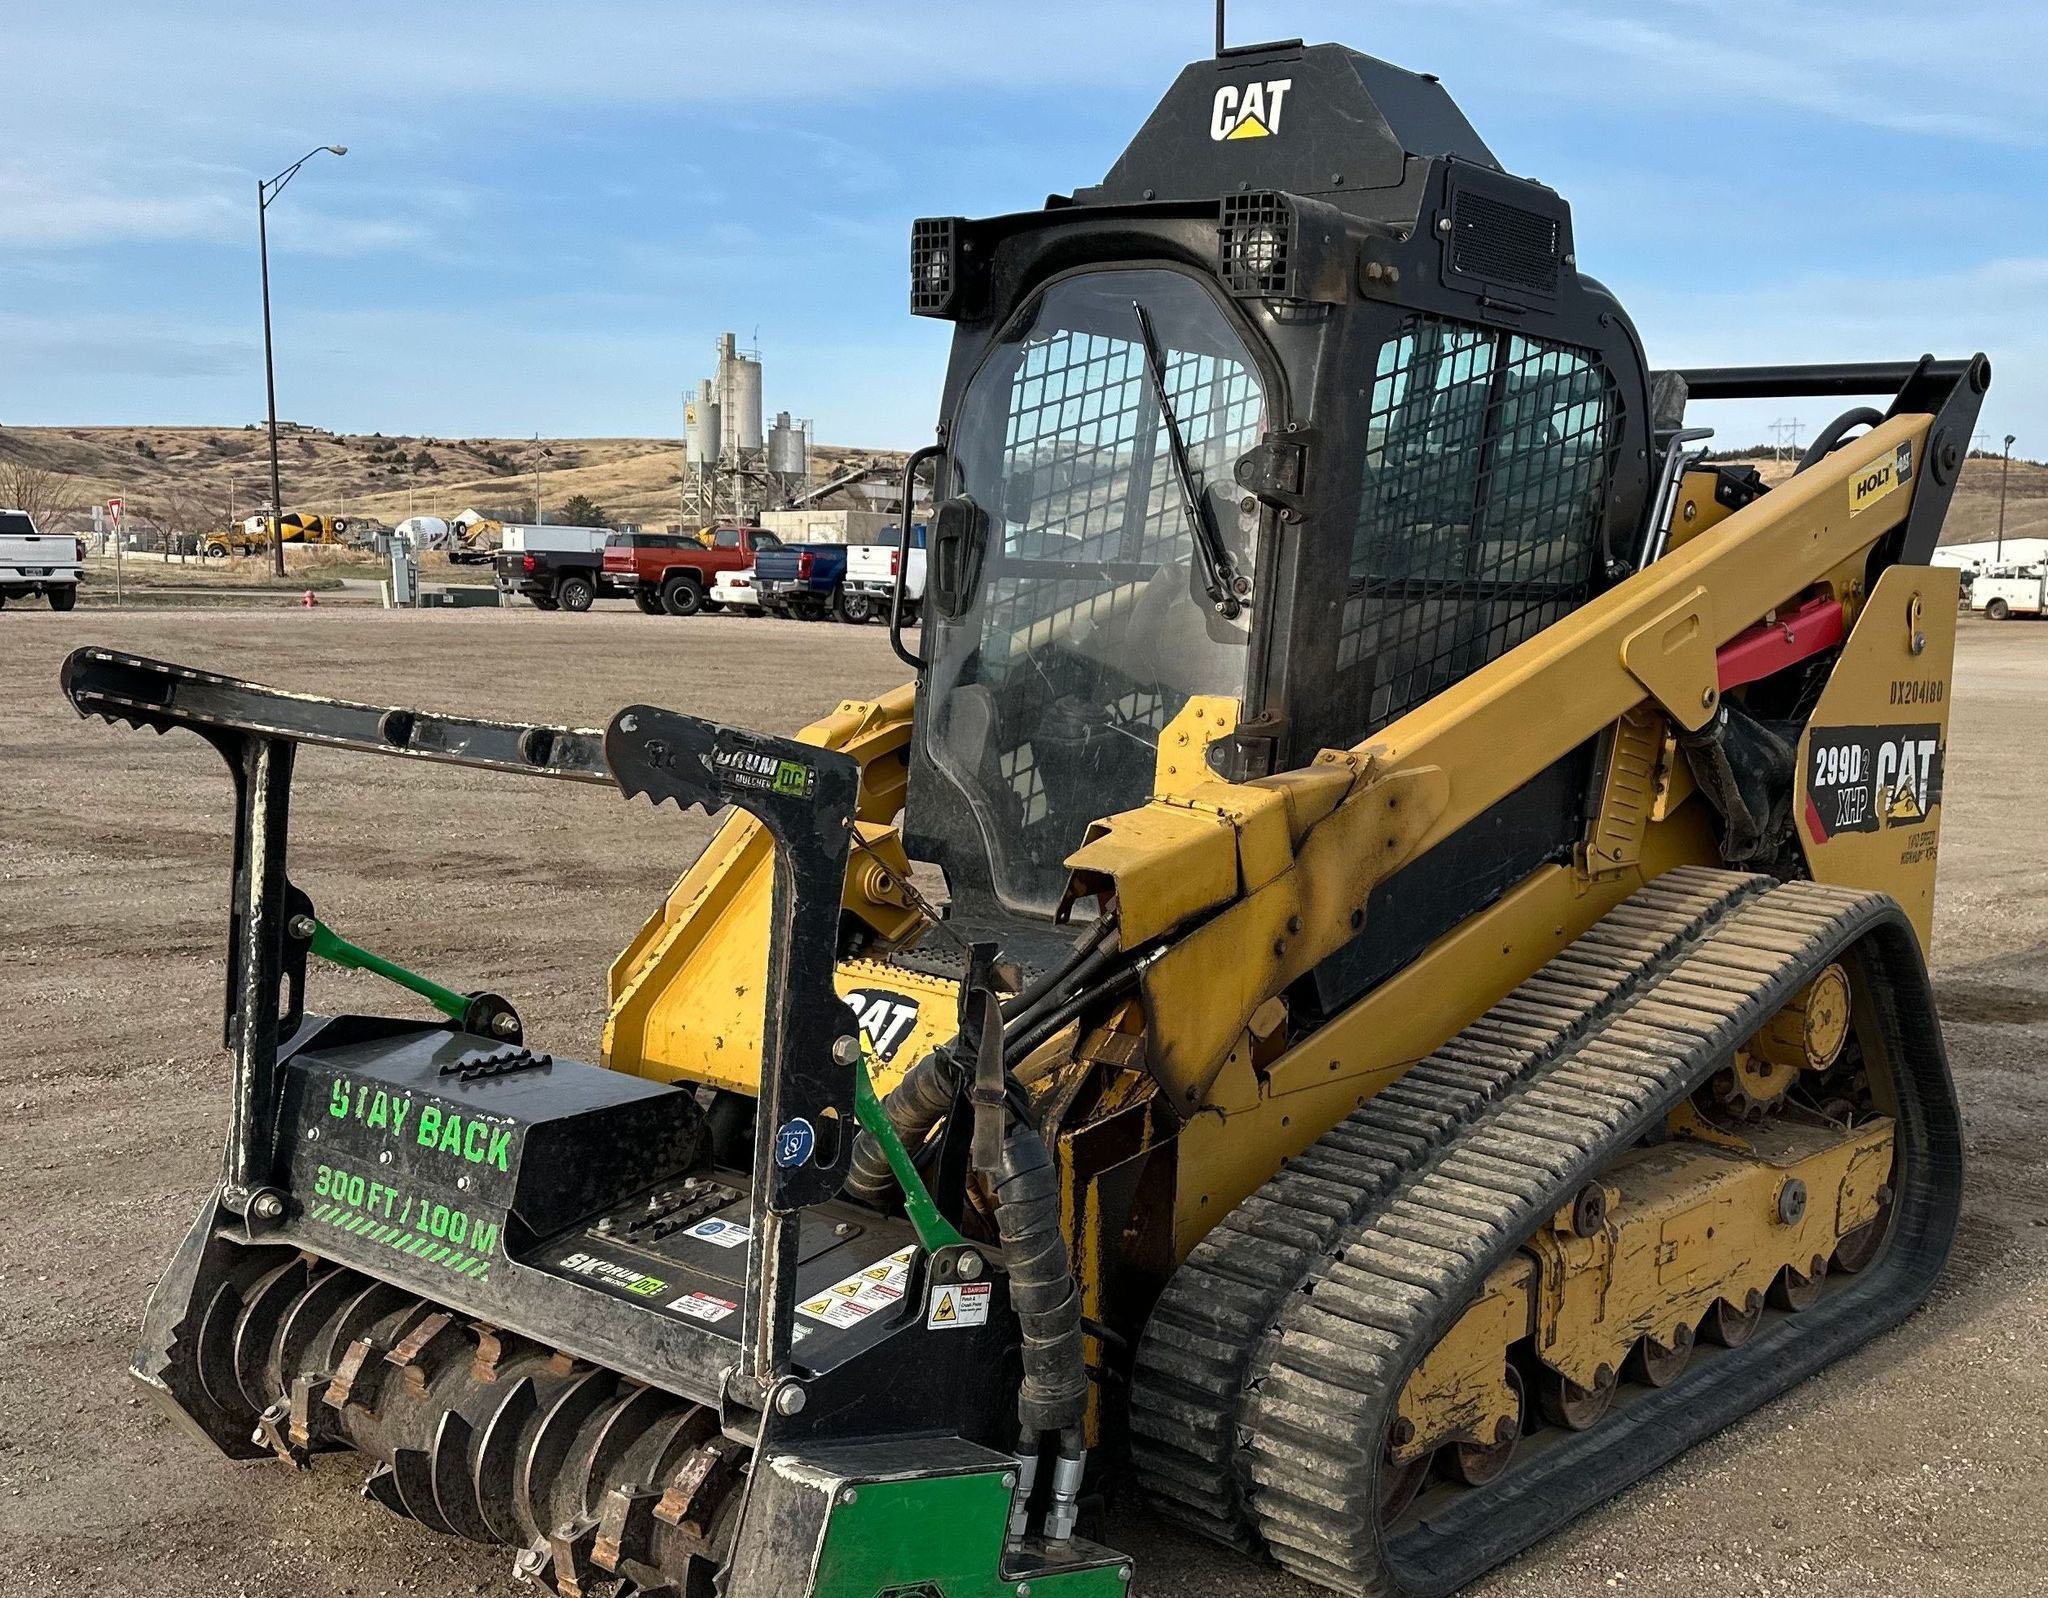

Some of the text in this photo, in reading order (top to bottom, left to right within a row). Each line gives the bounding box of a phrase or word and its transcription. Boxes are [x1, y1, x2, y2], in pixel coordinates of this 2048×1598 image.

[1210, 79, 1292, 141] CAT
[1856, 467, 1890, 500] HOLT
[1835, 786, 1868, 826] XHP
[1875, 740, 1936, 817] CAT
[329, 1078, 512, 1172] STAY BACK
